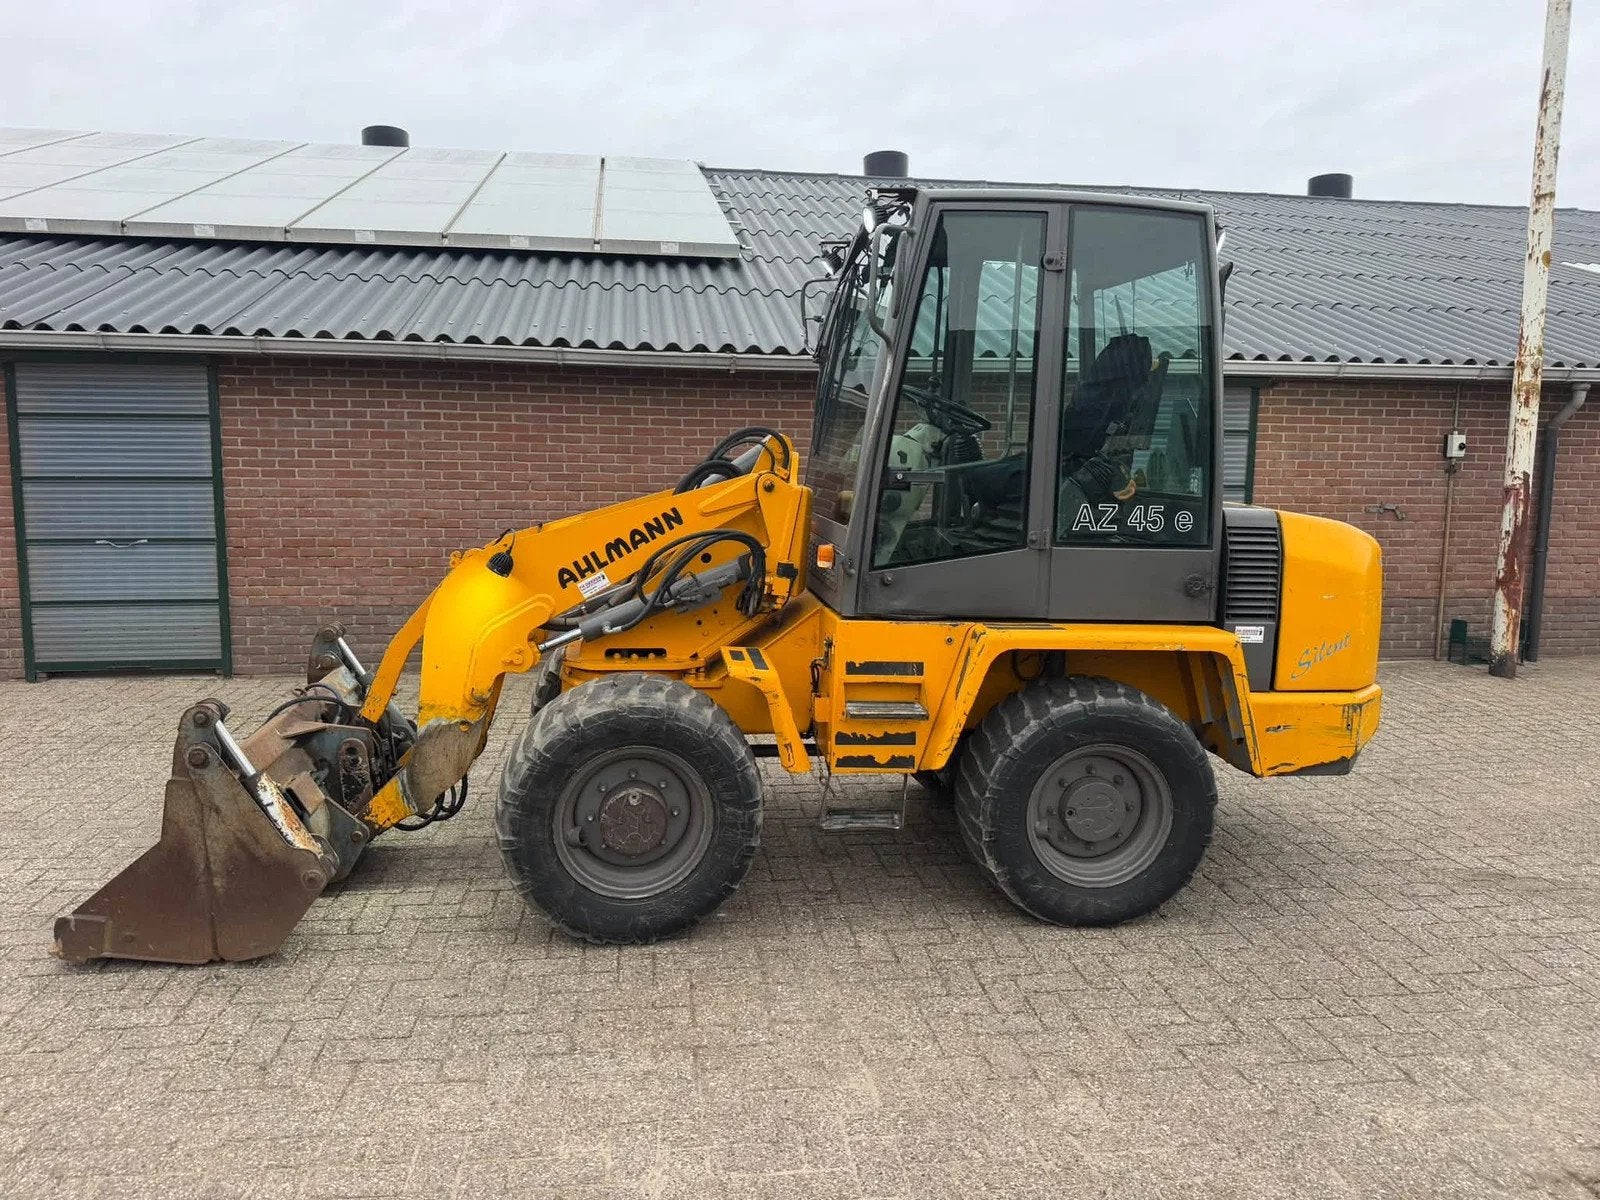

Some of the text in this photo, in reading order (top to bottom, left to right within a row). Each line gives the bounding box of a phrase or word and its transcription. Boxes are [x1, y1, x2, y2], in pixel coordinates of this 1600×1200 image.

[1072, 503, 1194, 532] AZ 45 e
[558, 507, 684, 589] AHLMANN
[1291, 631, 1351, 680] Silent
